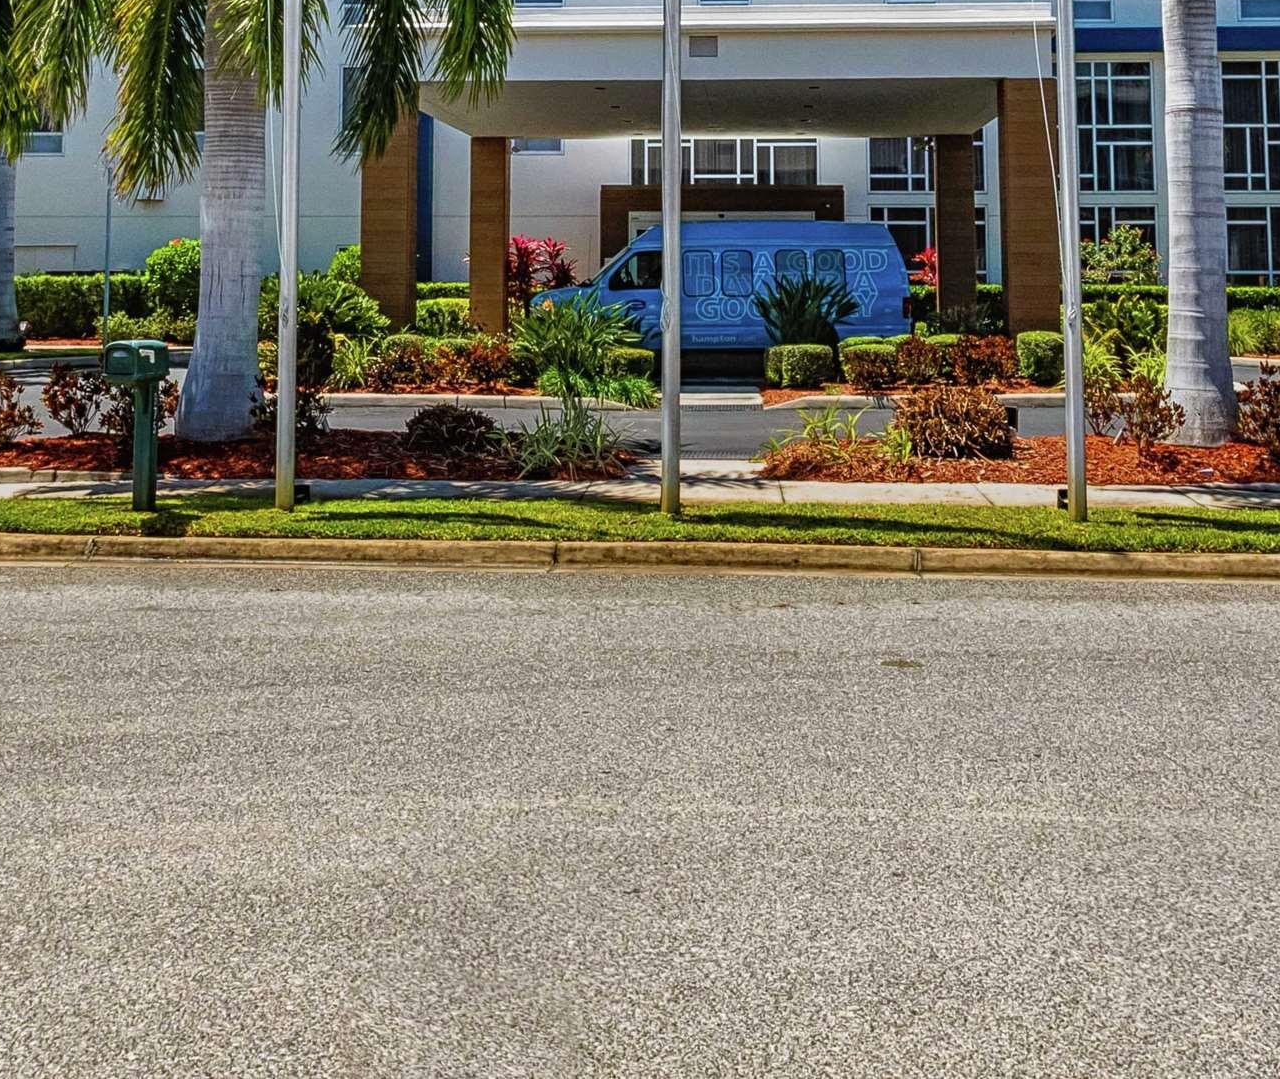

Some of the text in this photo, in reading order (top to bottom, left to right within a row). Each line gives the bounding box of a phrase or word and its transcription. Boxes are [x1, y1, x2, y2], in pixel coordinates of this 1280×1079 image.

[688, 248, 888, 276] IT'S A GOOD
[853, 271, 878, 295] A
